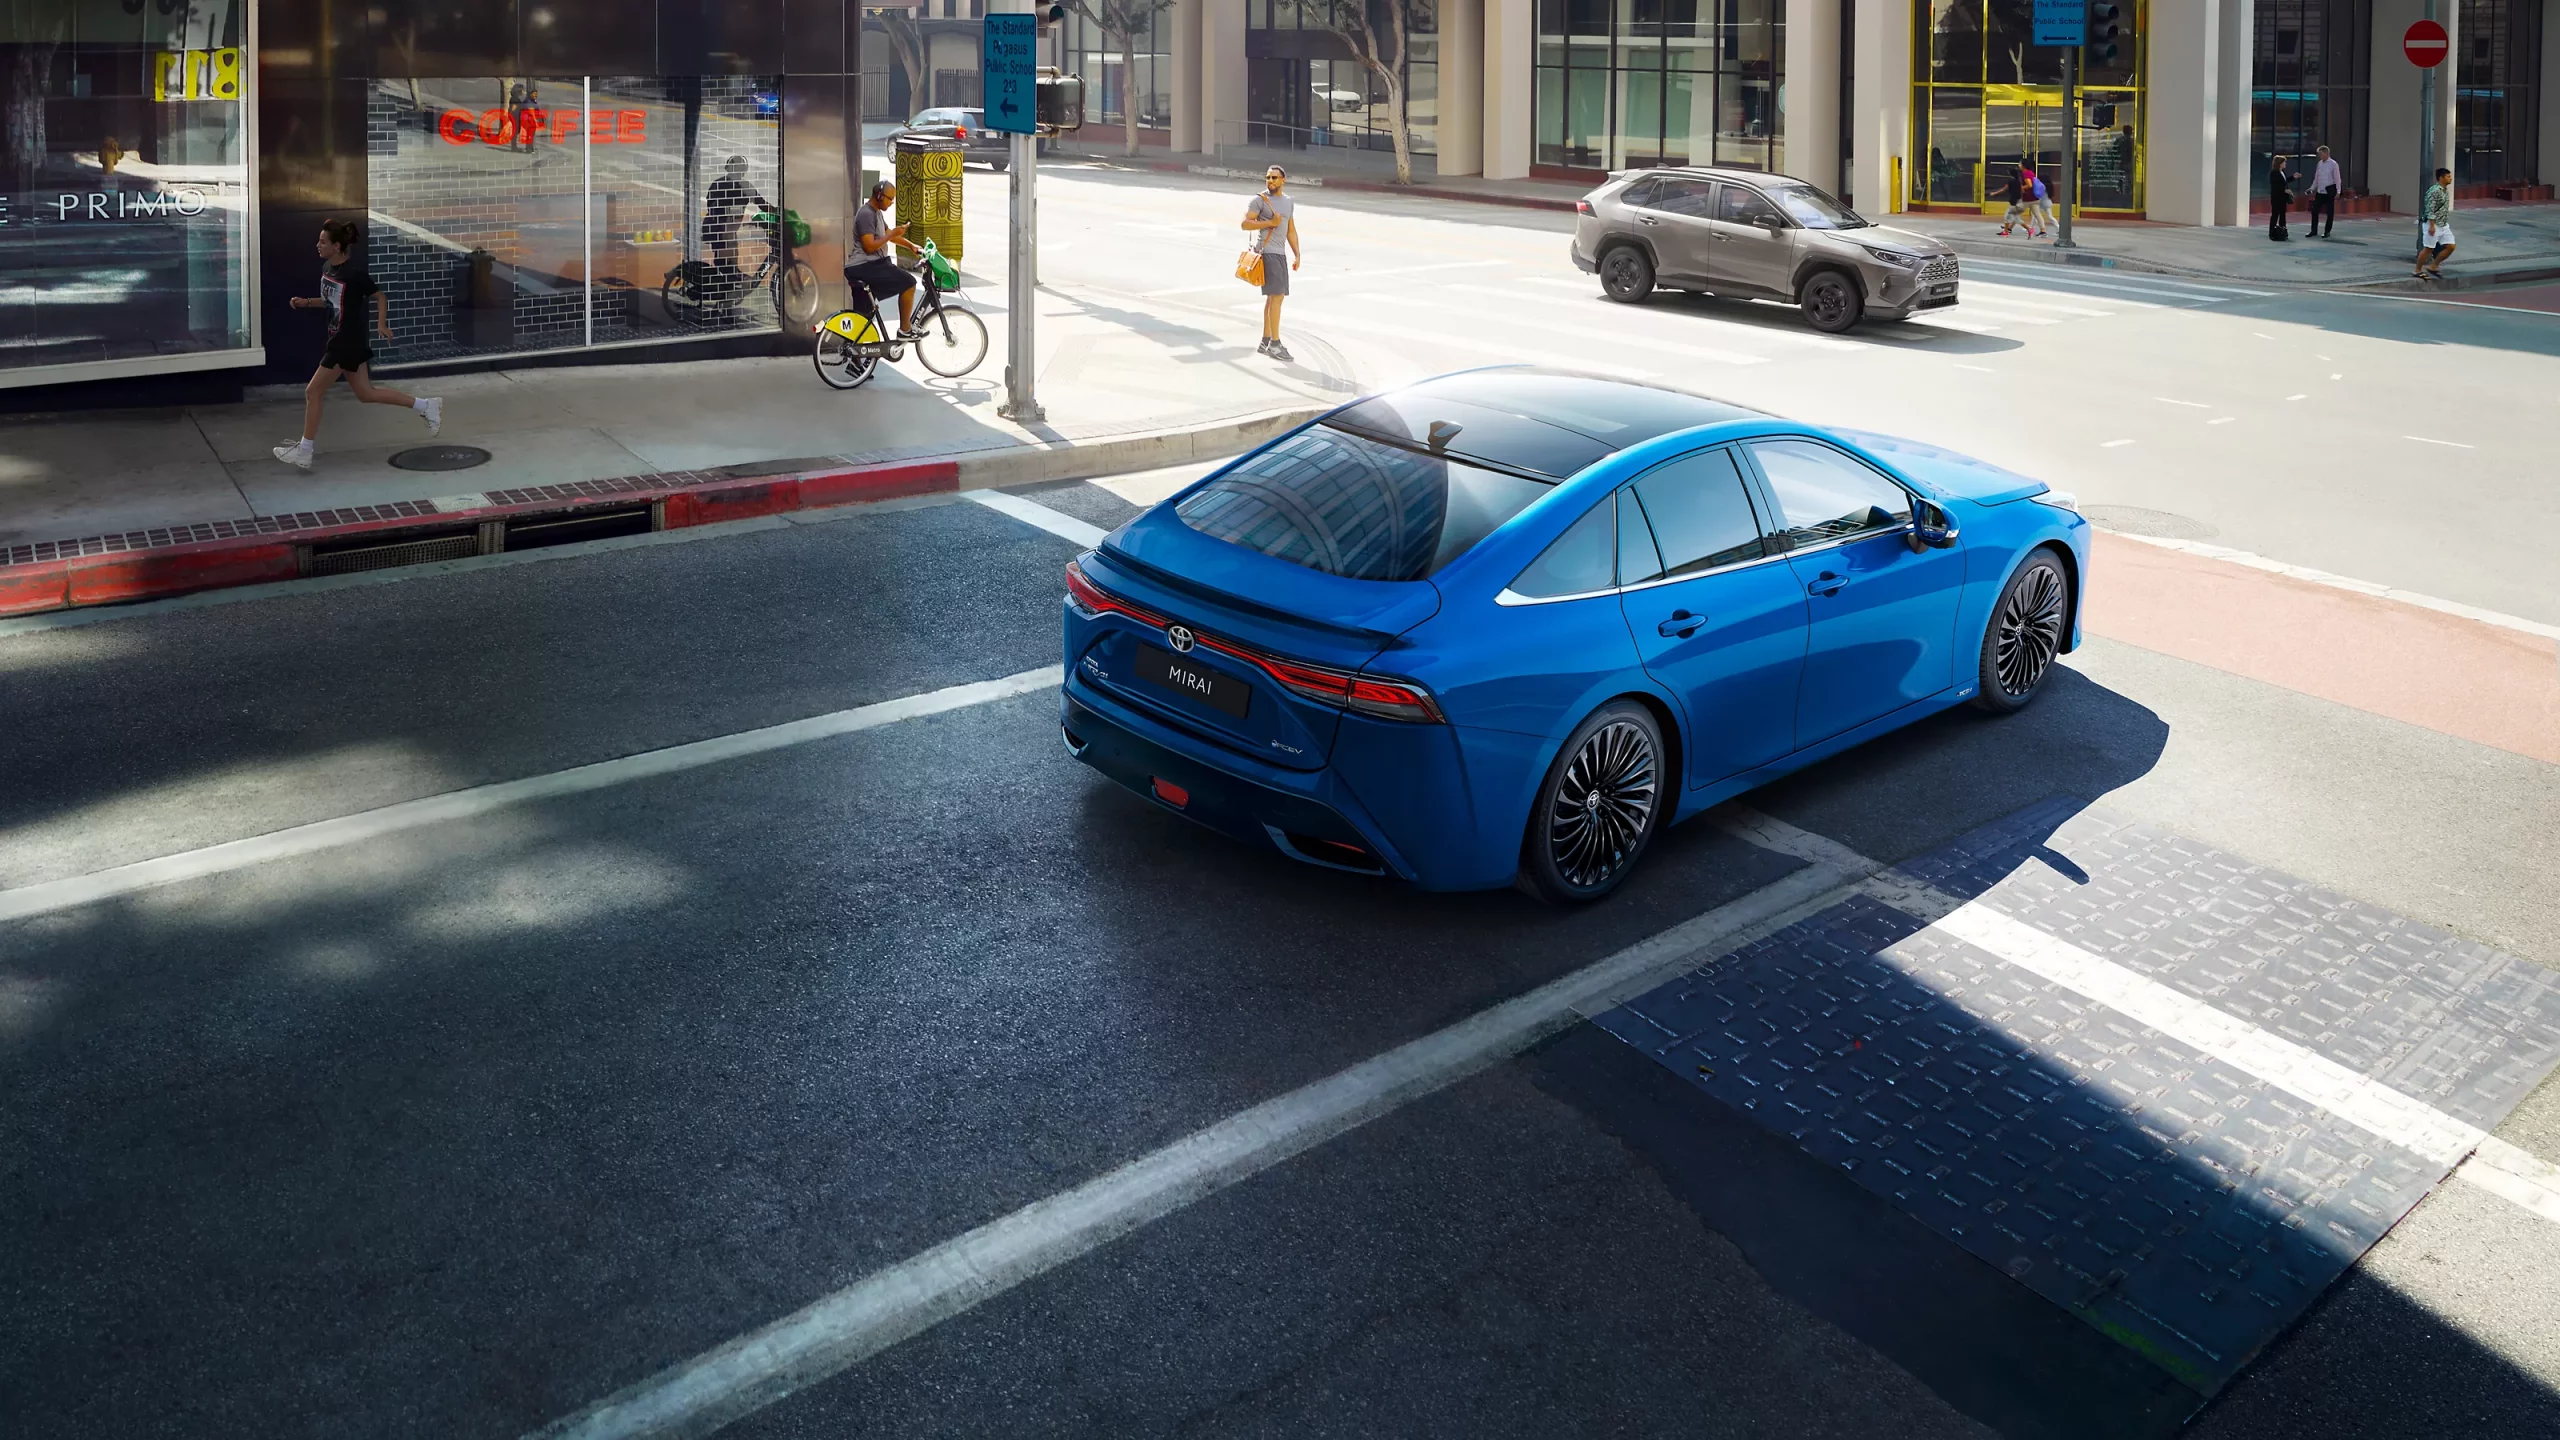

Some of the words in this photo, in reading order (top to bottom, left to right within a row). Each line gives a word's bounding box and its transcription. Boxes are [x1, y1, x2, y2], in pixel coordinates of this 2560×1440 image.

[2037, 0, 2048, 8] The
[2051, 0, 2083, 8] Standard
[987, 20, 999, 35] The
[1002, 20, 1034, 36] Standard
[993, 40, 1028, 57] Pegasus
[985, 59, 1007, 74] Public
[1010, 60, 1035, 76] School
[439, 108, 647, 146] COFFEE
[58, 189, 207, 221] PRIMO
[842, 319, 851, 330] M
[1169, 665, 1212, 695] MIRAI
